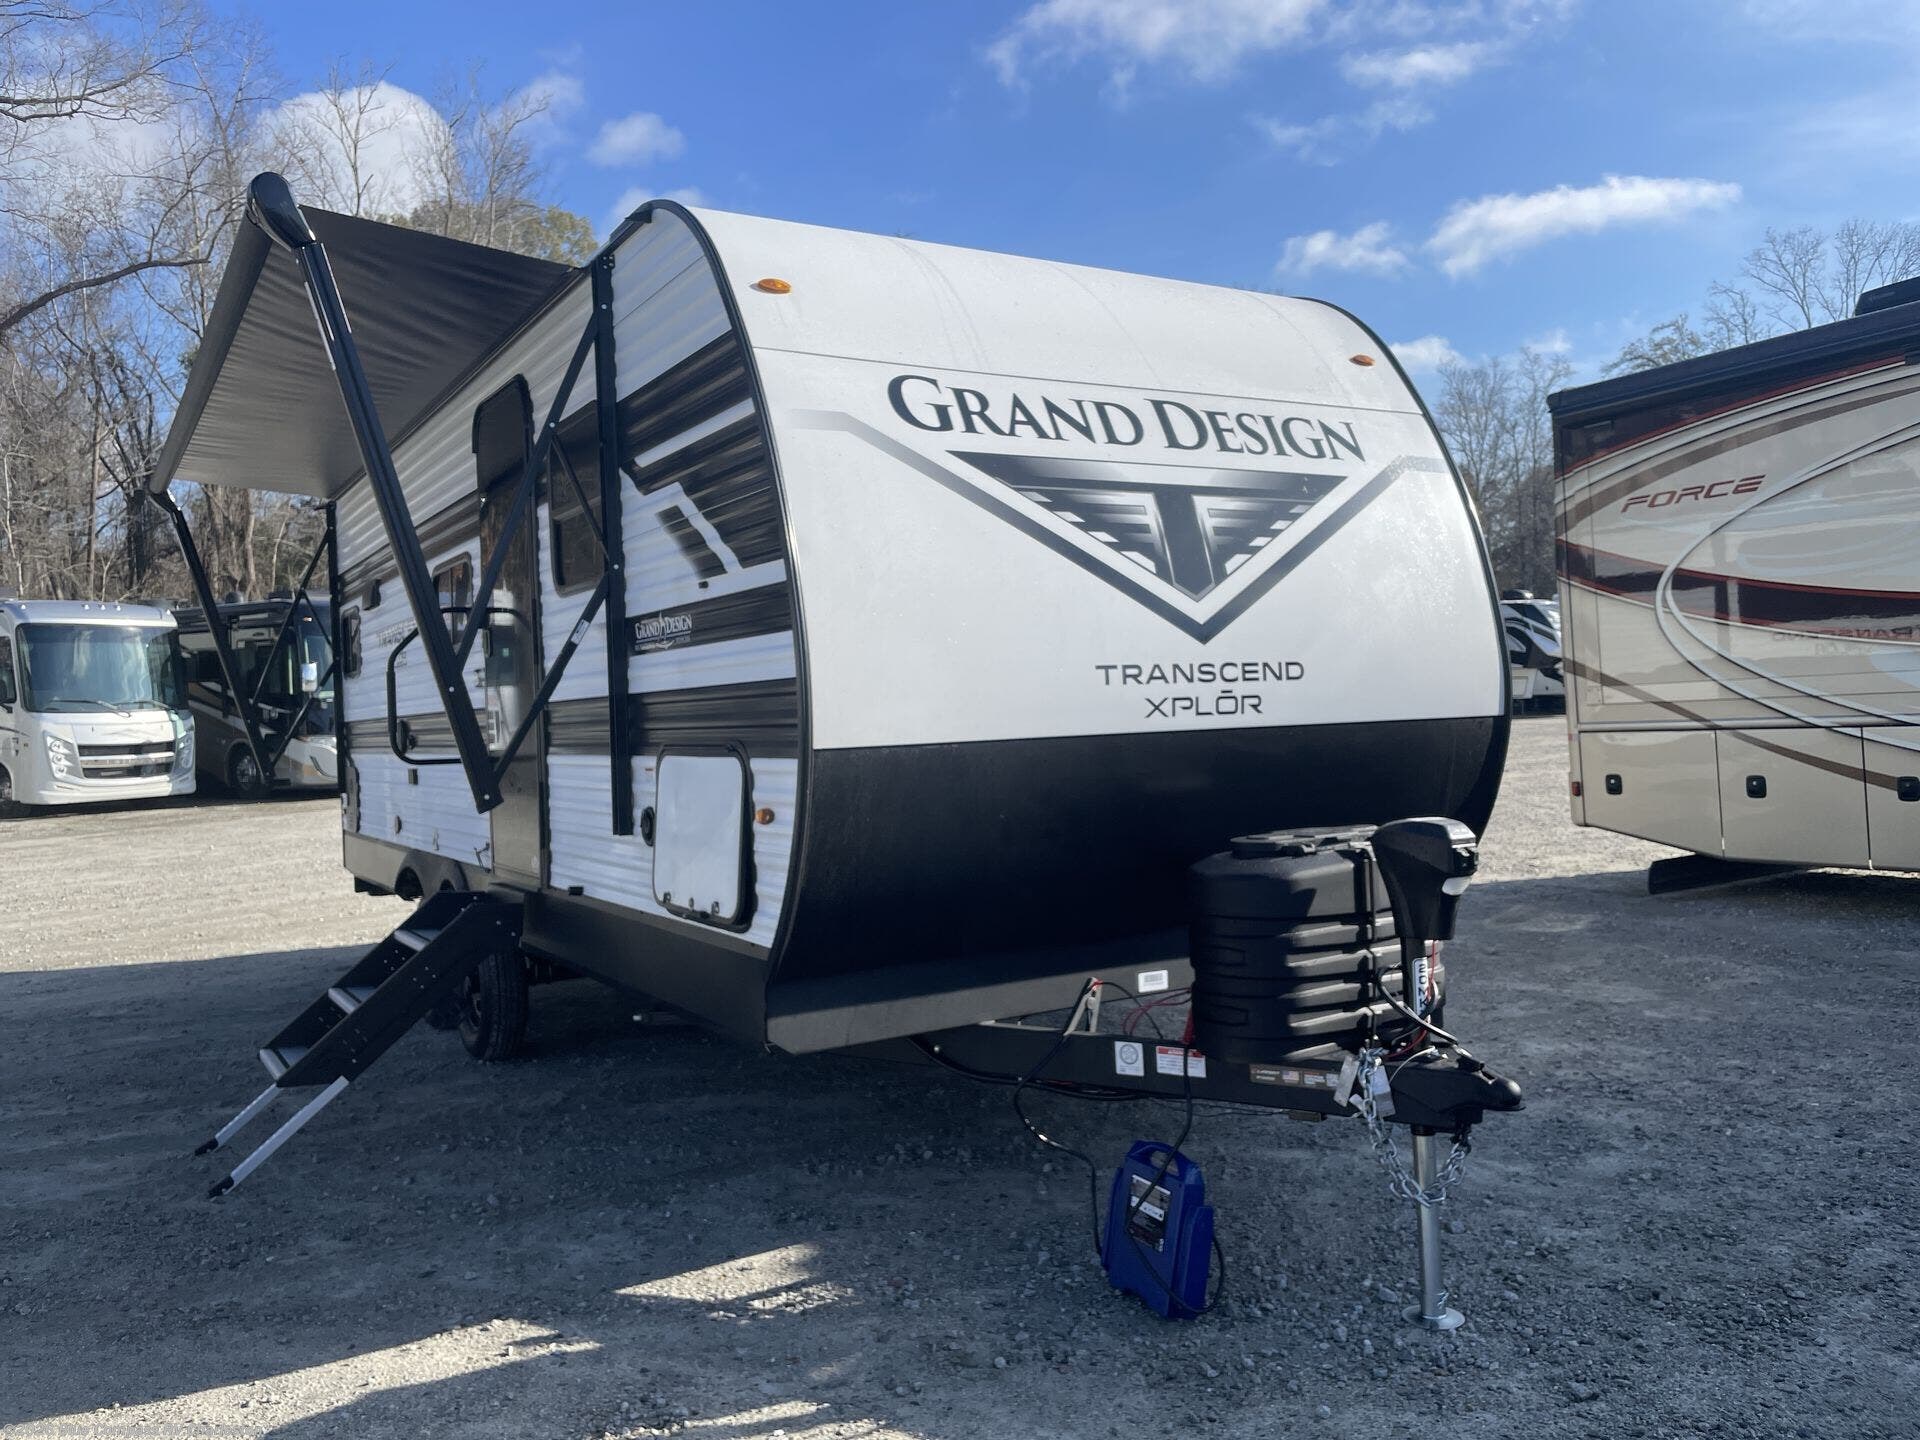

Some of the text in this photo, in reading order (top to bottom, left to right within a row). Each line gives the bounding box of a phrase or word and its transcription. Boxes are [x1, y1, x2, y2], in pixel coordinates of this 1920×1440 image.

[887, 374, 1366, 463] GRAND DESIGN
[1620, 474, 1766, 513] FORCE
[635, 614, 693, 640] GRAND DESIGN
[1095, 662, 1305, 686] TRANSCEND
